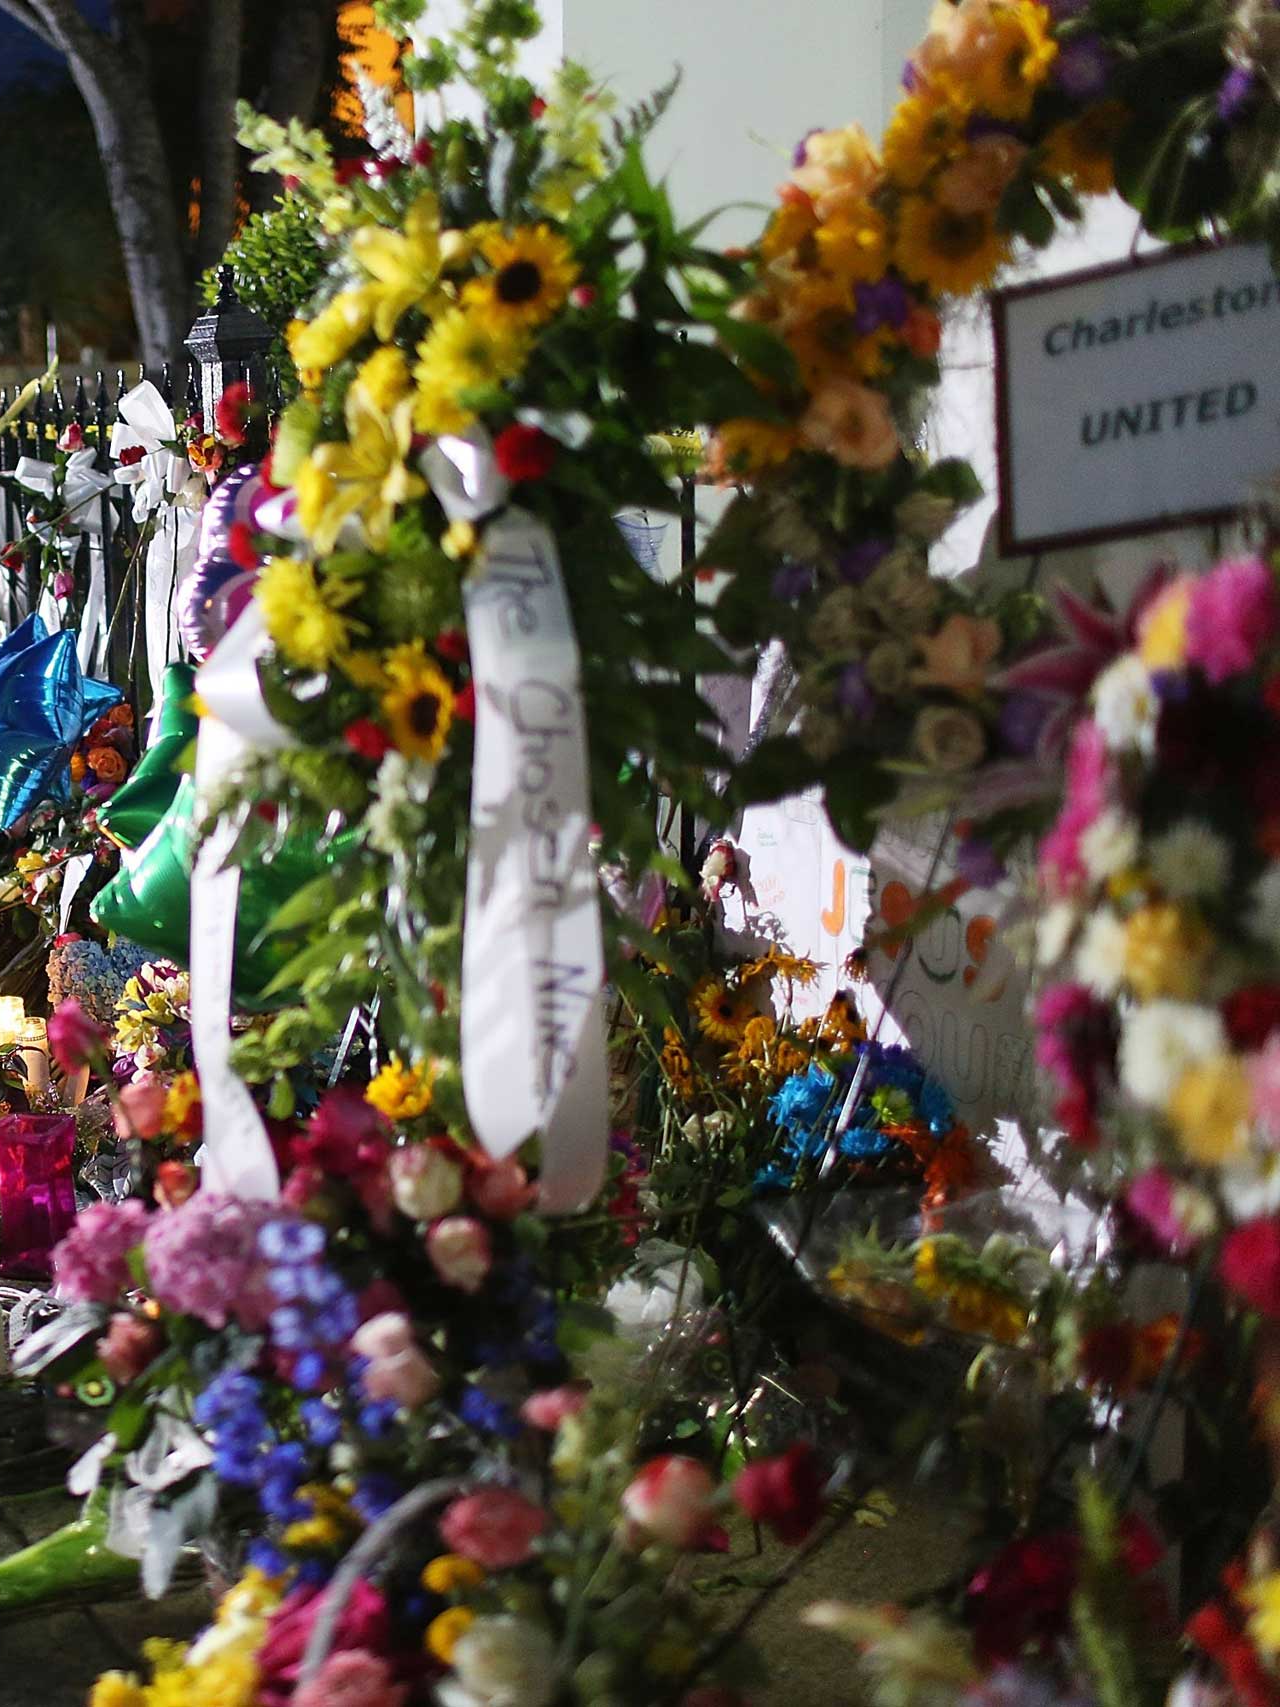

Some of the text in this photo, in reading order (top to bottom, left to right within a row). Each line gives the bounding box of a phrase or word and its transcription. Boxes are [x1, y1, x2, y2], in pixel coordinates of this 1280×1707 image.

[1080, 380, 1257, 448] UNITED
[486, 539, 556, 638] The
[510, 678, 576, 909] Chosen
